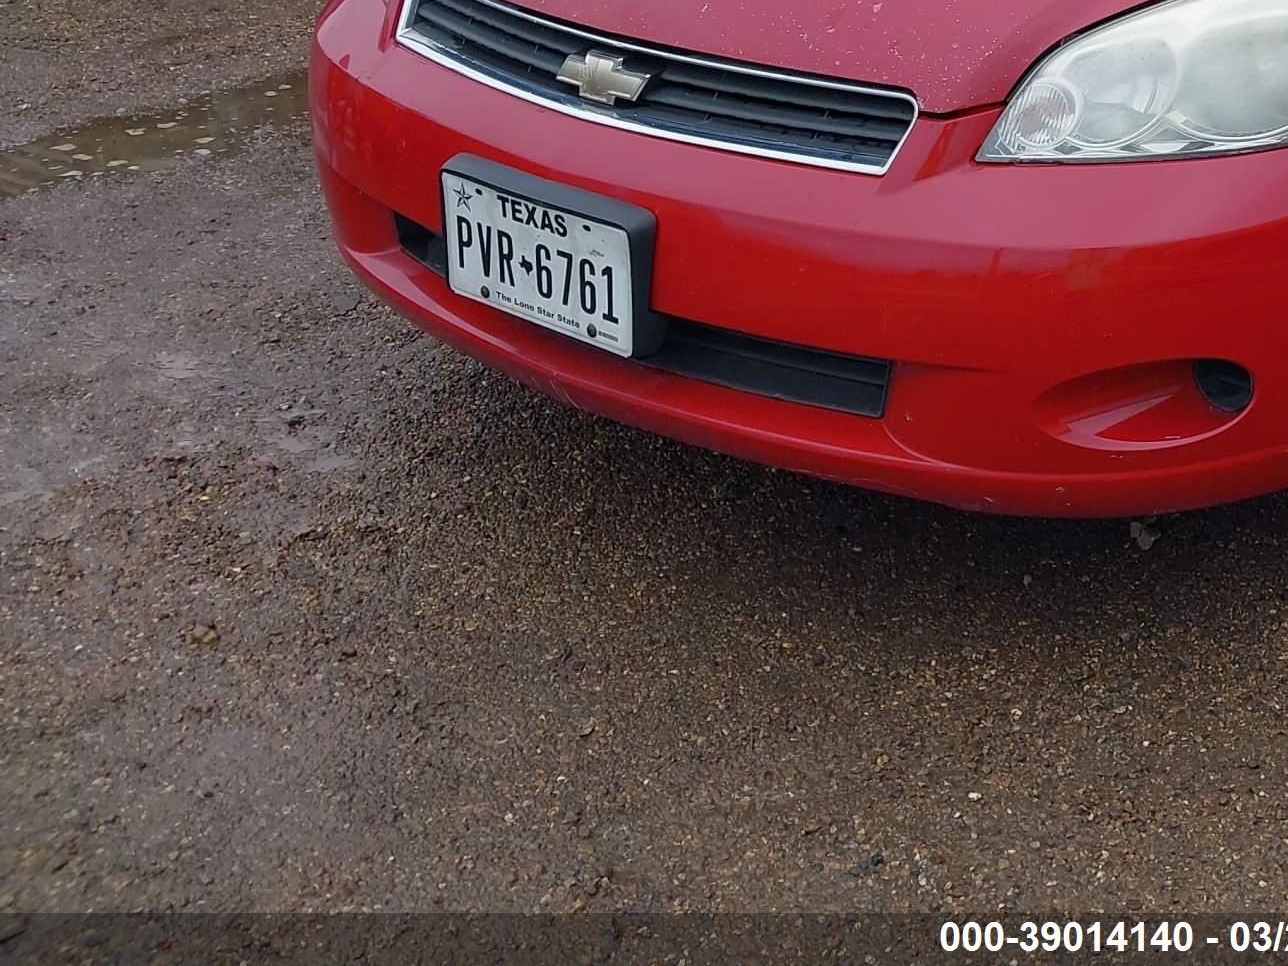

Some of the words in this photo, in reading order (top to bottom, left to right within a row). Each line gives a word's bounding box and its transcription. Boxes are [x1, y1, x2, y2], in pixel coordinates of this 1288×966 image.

[496, 194, 568, 238] TEXAS
[496, 291, 512, 304] The
[514, 297, 535, 313] Lone
[537, 305, 555, 320] Star
[557, 312, 580, 329] State
